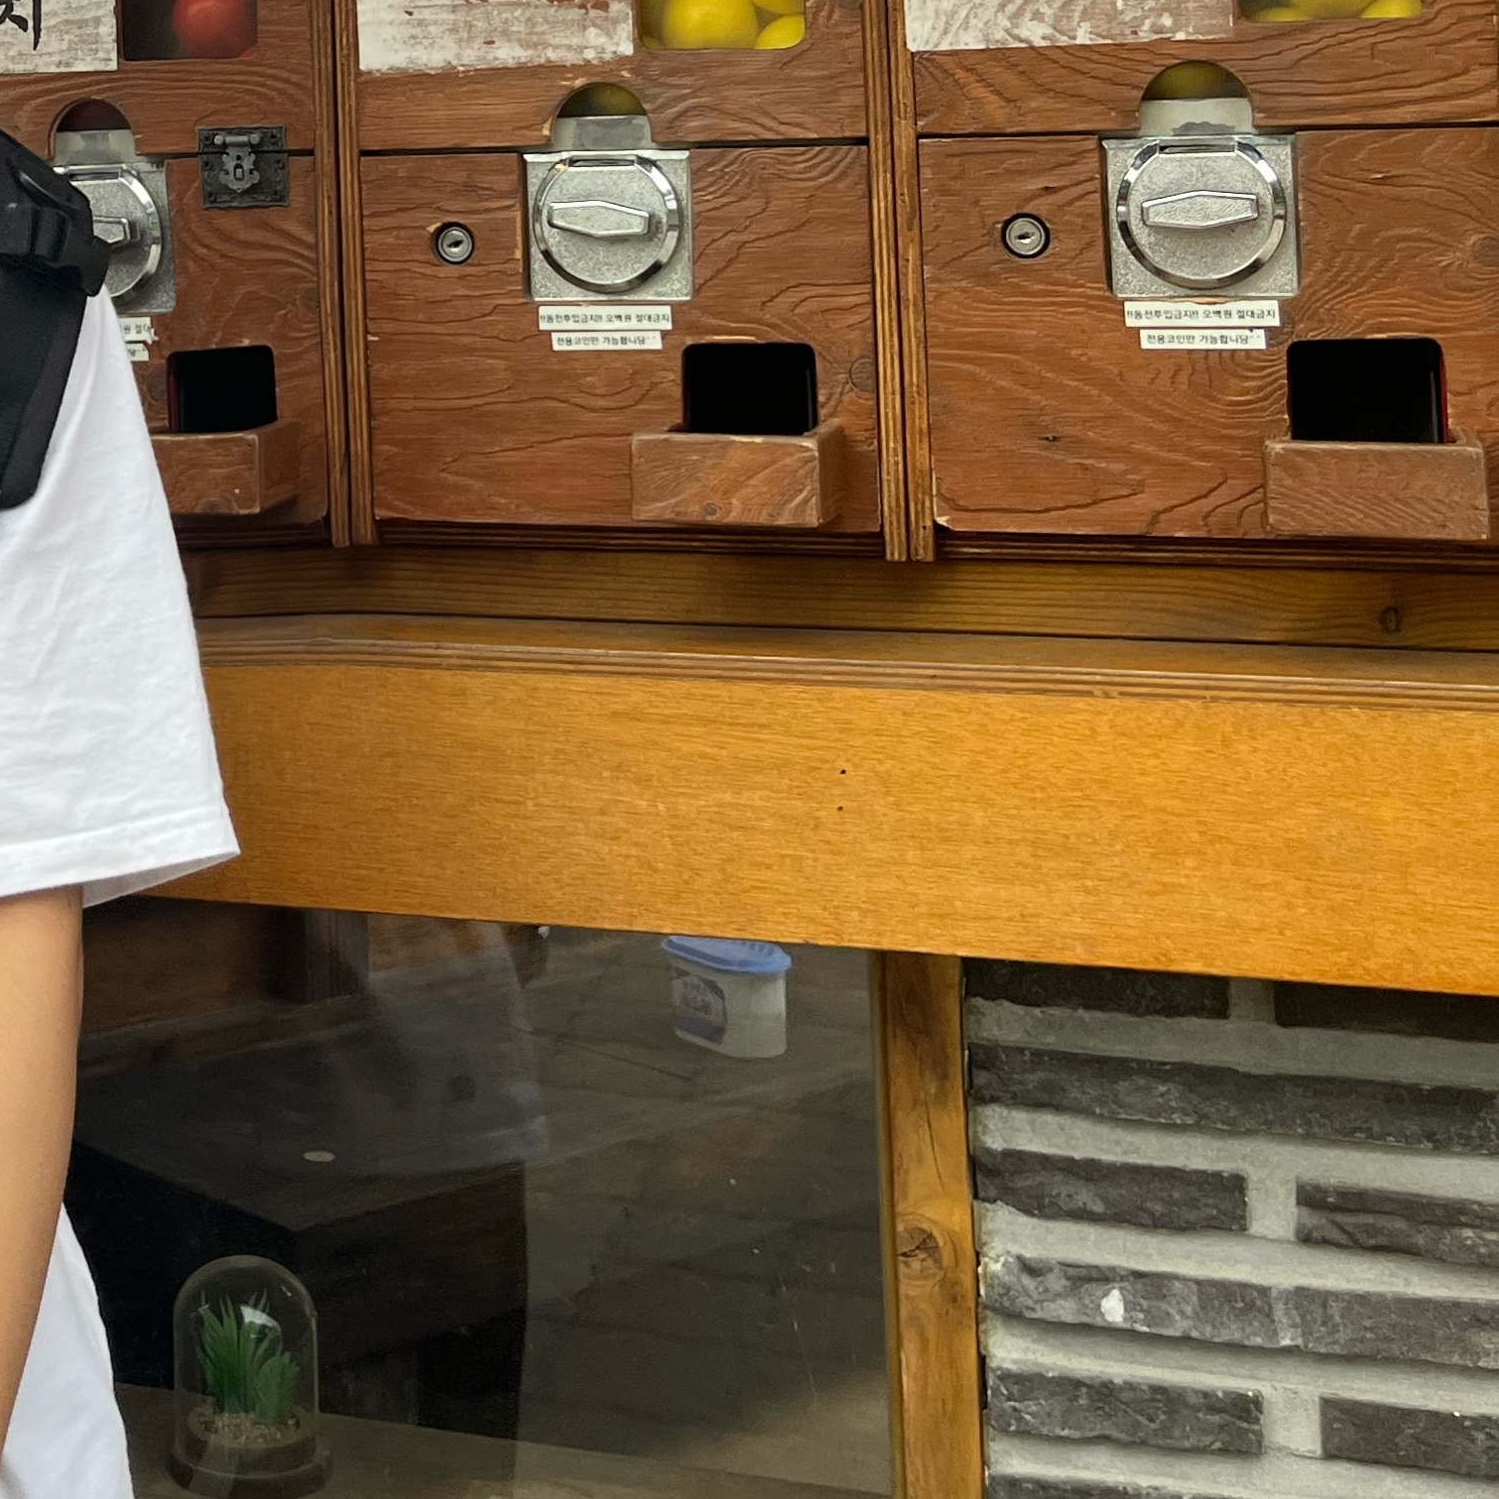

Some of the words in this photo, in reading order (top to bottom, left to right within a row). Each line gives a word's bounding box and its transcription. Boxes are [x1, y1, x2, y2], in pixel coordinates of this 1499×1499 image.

[606, 313, 633, 323] 오백원
[635, 313, 670, 323] 절대금지
[1203, 309, 1232, 320] 오백원
[1236, 309, 1276, 320] 절대금지
